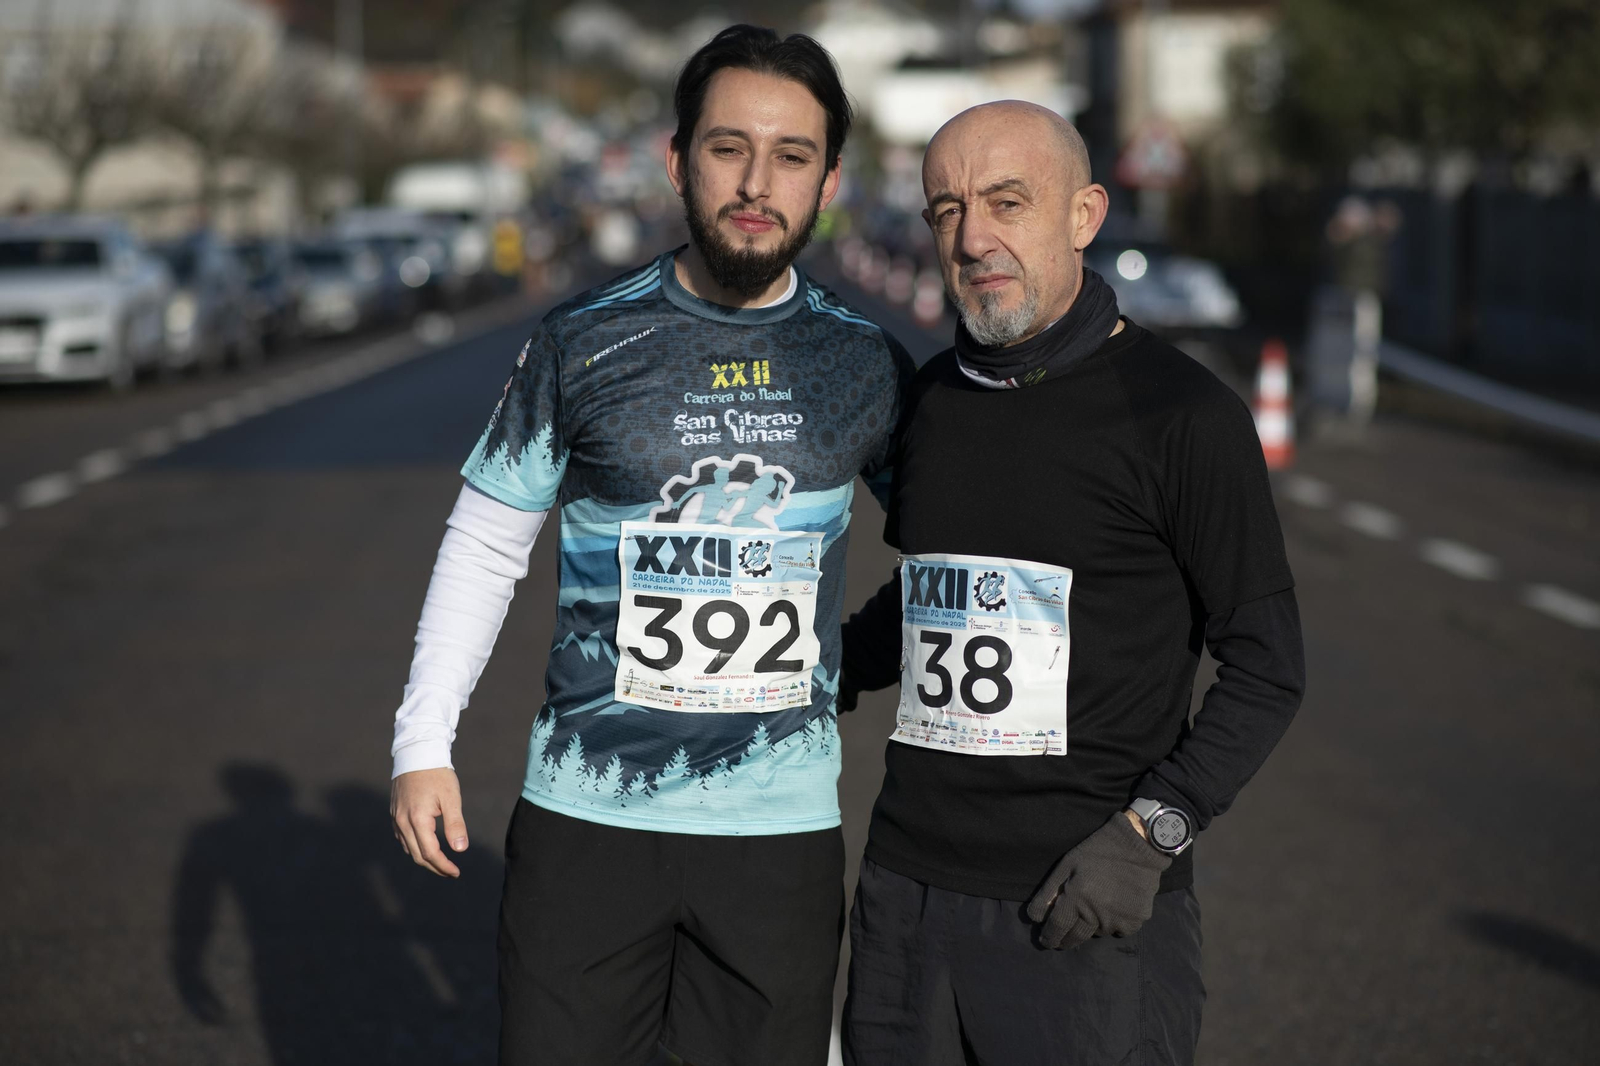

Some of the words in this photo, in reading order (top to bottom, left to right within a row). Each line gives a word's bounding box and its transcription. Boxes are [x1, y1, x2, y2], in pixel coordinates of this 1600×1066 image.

[586, 326, 657, 367] FIREHAWK
[684, 392, 734, 404] Carreira
[740, 391, 755, 401] do
[758, 388, 792, 401] Nadal
[673, 409, 717, 431] San
[724, 408, 803, 429] Cibrao
[681, 430, 722, 446] das
[634, 535, 732, 577] XXII
[632, 573, 675, 584] CARREIRA
[681, 577, 693, 585] DO
[699, 578, 731, 587] NADAL
[653, 584, 695, 592] decembro
[908, 565, 969, 610] XXII
[930, 609, 939, 618] DO
[941, 610, 967, 620] NADAL
[949, 620, 967, 628] 2025
[627, 594, 804, 674] 392
[917, 630, 1013, 714] 38
